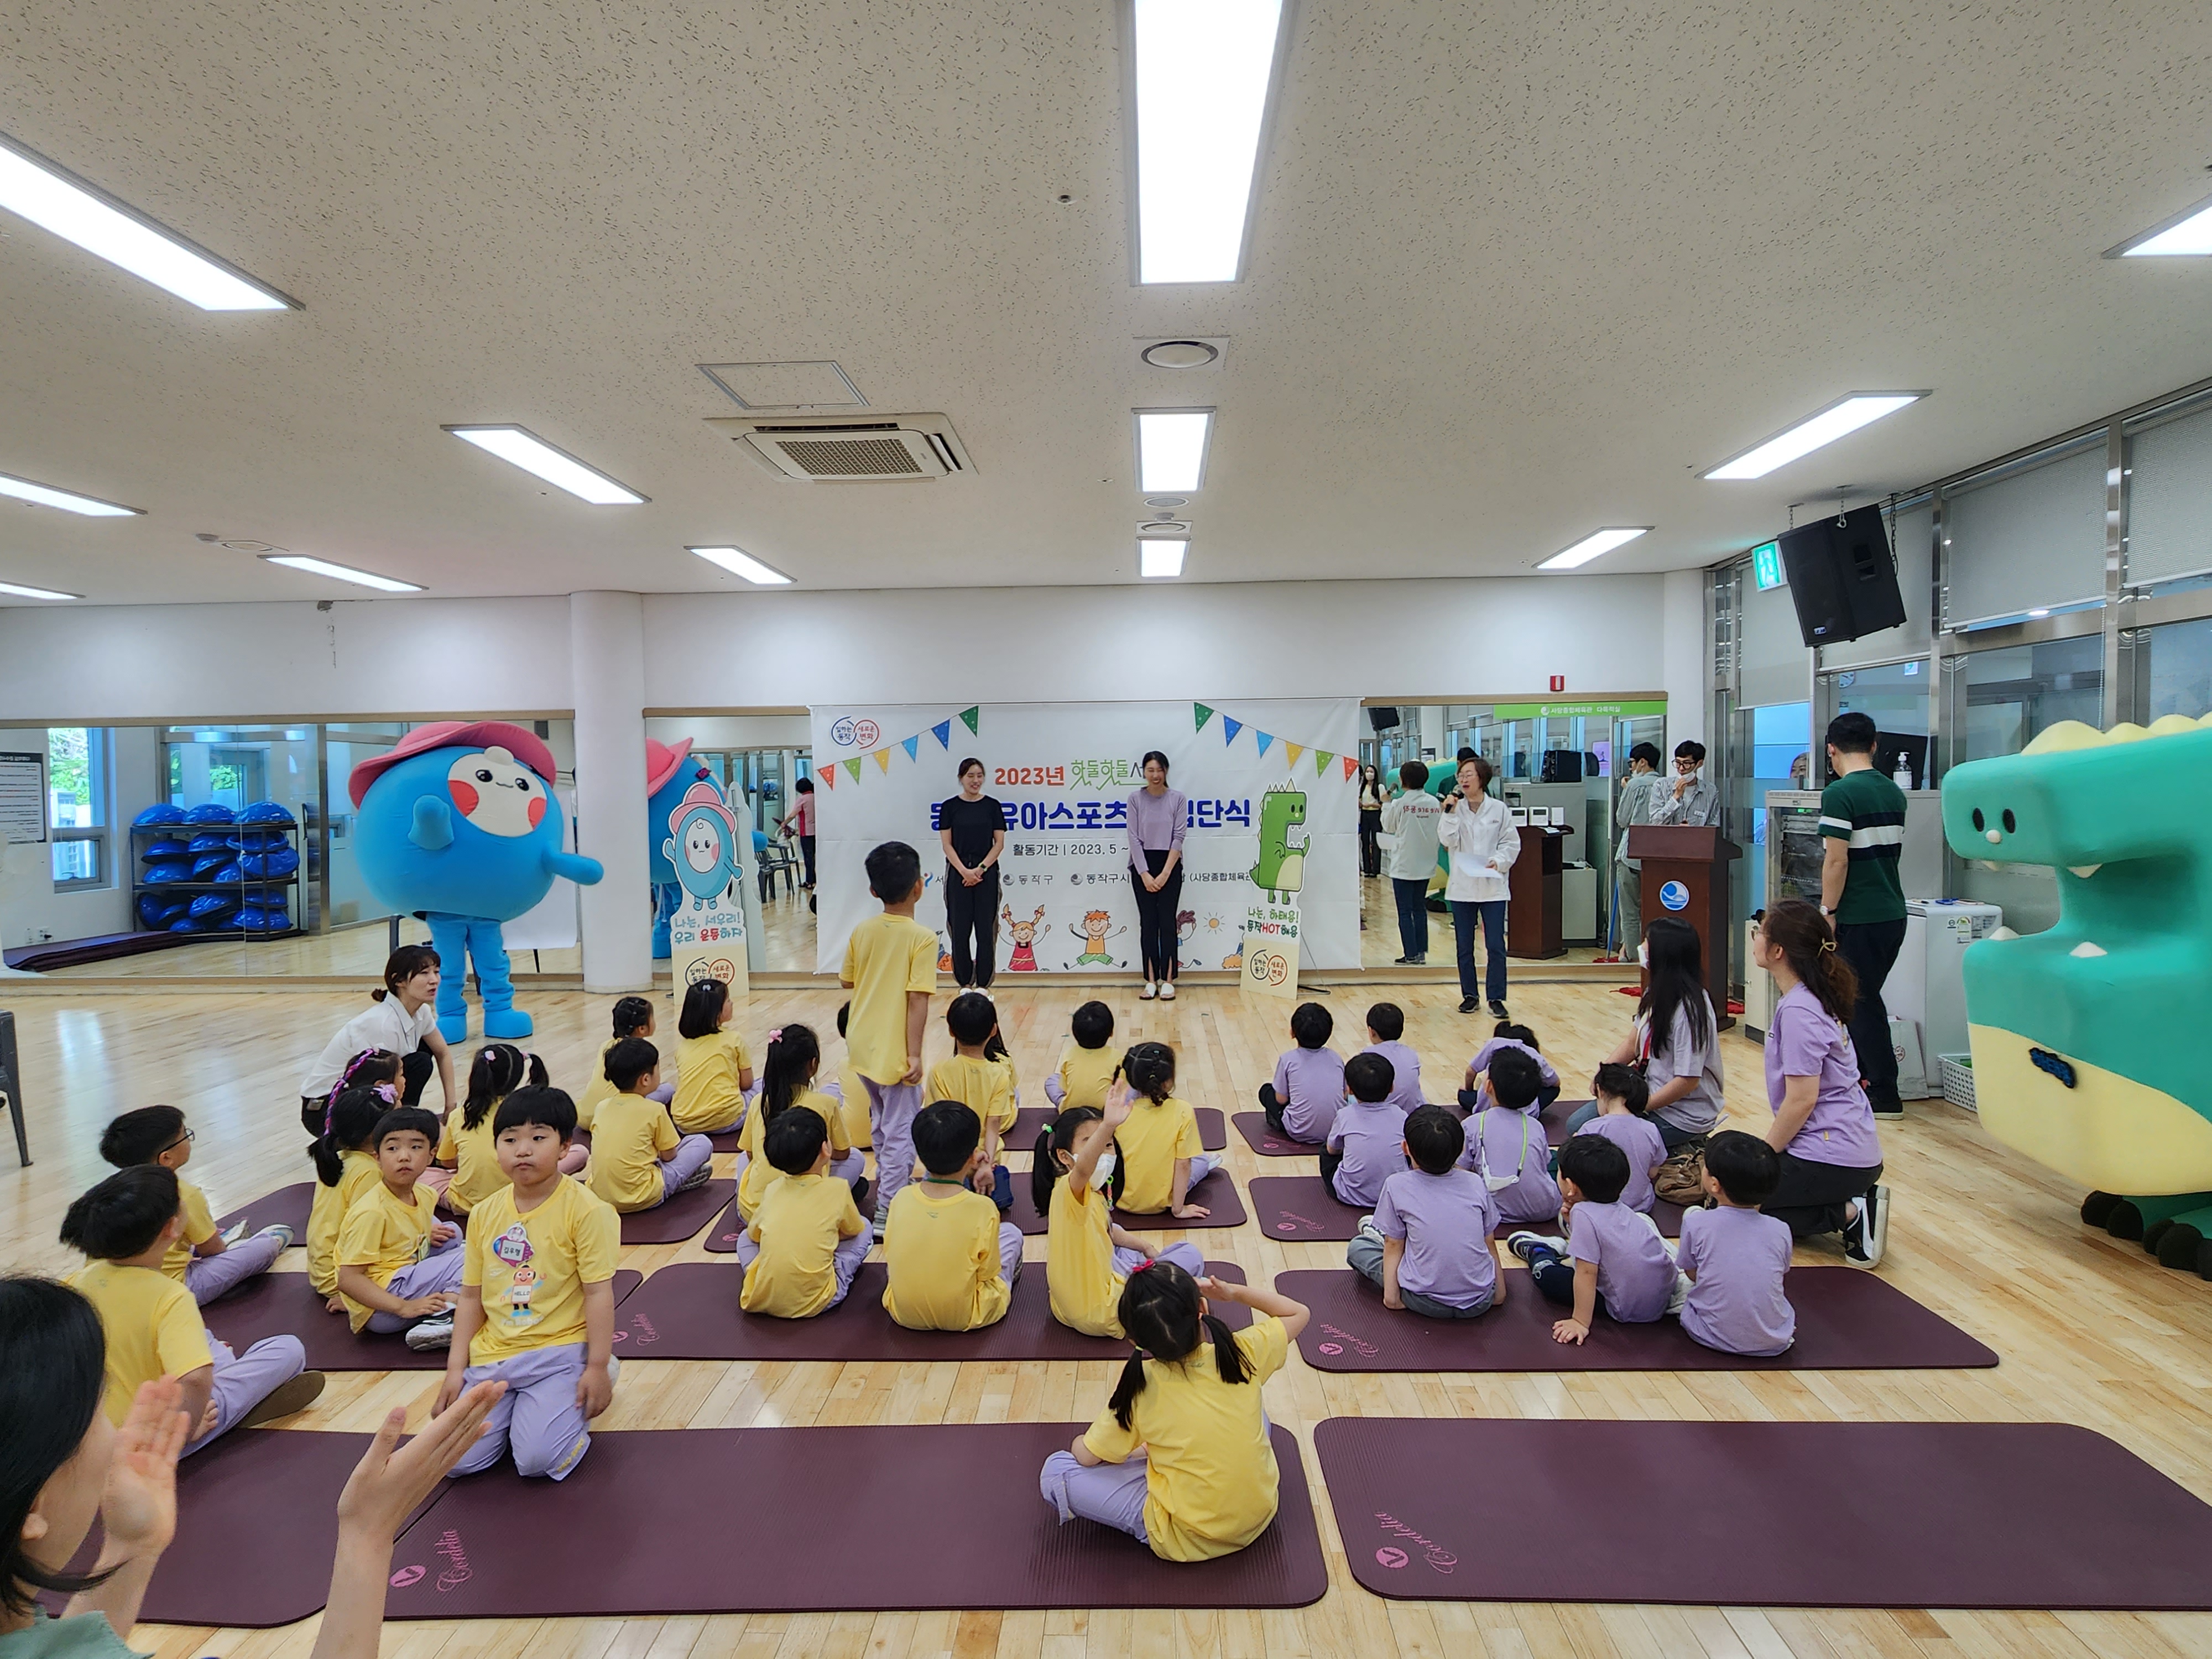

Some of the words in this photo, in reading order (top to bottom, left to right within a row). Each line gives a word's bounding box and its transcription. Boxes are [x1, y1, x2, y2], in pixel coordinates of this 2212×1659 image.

[838, 733, 851, 741] 동작
[859, 733, 874, 741] 변화
[995, 766, 1065, 786] 2023년
[1001, 801, 1128, 830] 유아스포츠
[1013, 844, 1058, 856] 활동기간
[1071, 844, 1105, 855] 2023.
[1109, 844, 1117, 854] 5
[1019, 875, 1053, 885] 동작구
[1248, 906, 1266, 920] 나는,
[675, 915, 700, 928] 나는,
[675, 931, 695, 945] 우리
[700, 927, 743, 941] 운동하자
